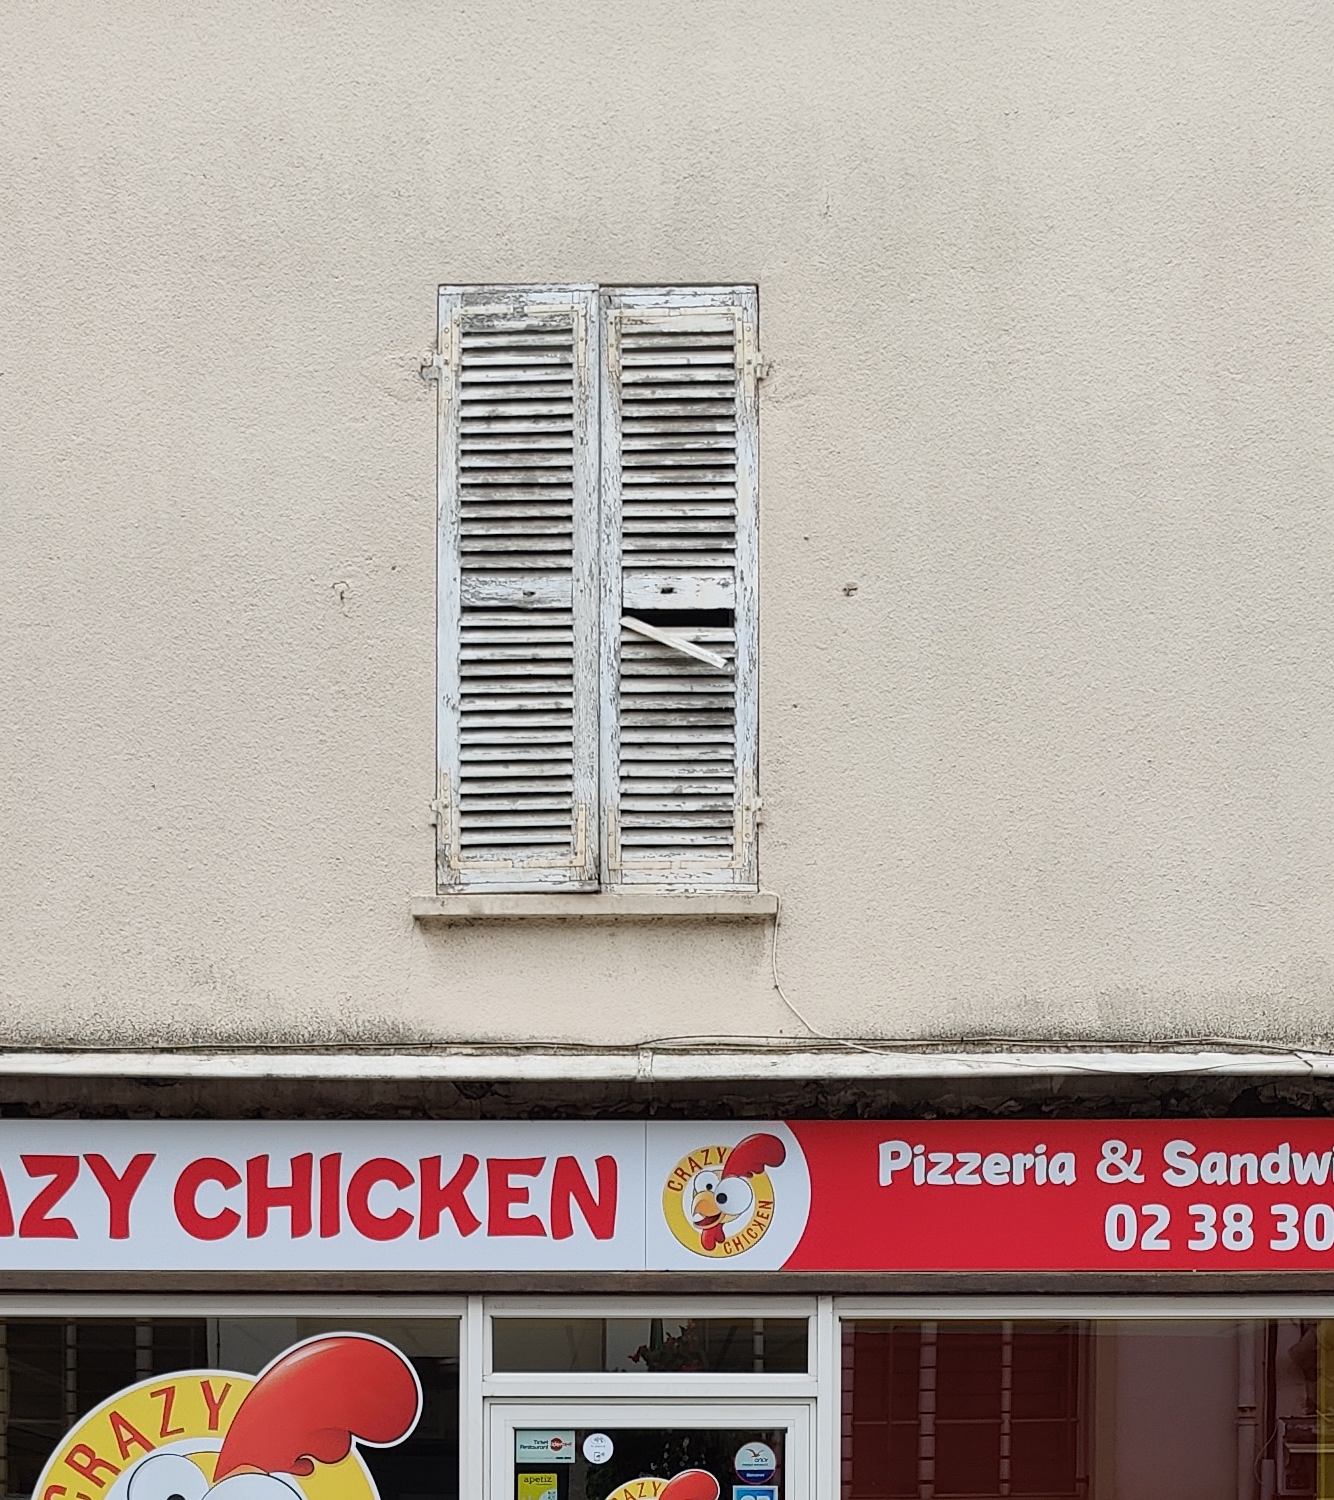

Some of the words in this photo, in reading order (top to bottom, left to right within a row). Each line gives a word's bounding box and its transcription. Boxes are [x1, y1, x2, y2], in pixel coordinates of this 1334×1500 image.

[667, 1147, 727, 1192] CRAZY
[878, 1139, 1077, 1187] Pizzeria
[1095, 1139, 1145, 1185] &
[173, 1151, 618, 1241] CHICKEN
[723, 1200, 774, 1255] CHICKEN
[1104, 1203, 1170, 1252] 02
[1187, 1203, 1254, 1252] 38
